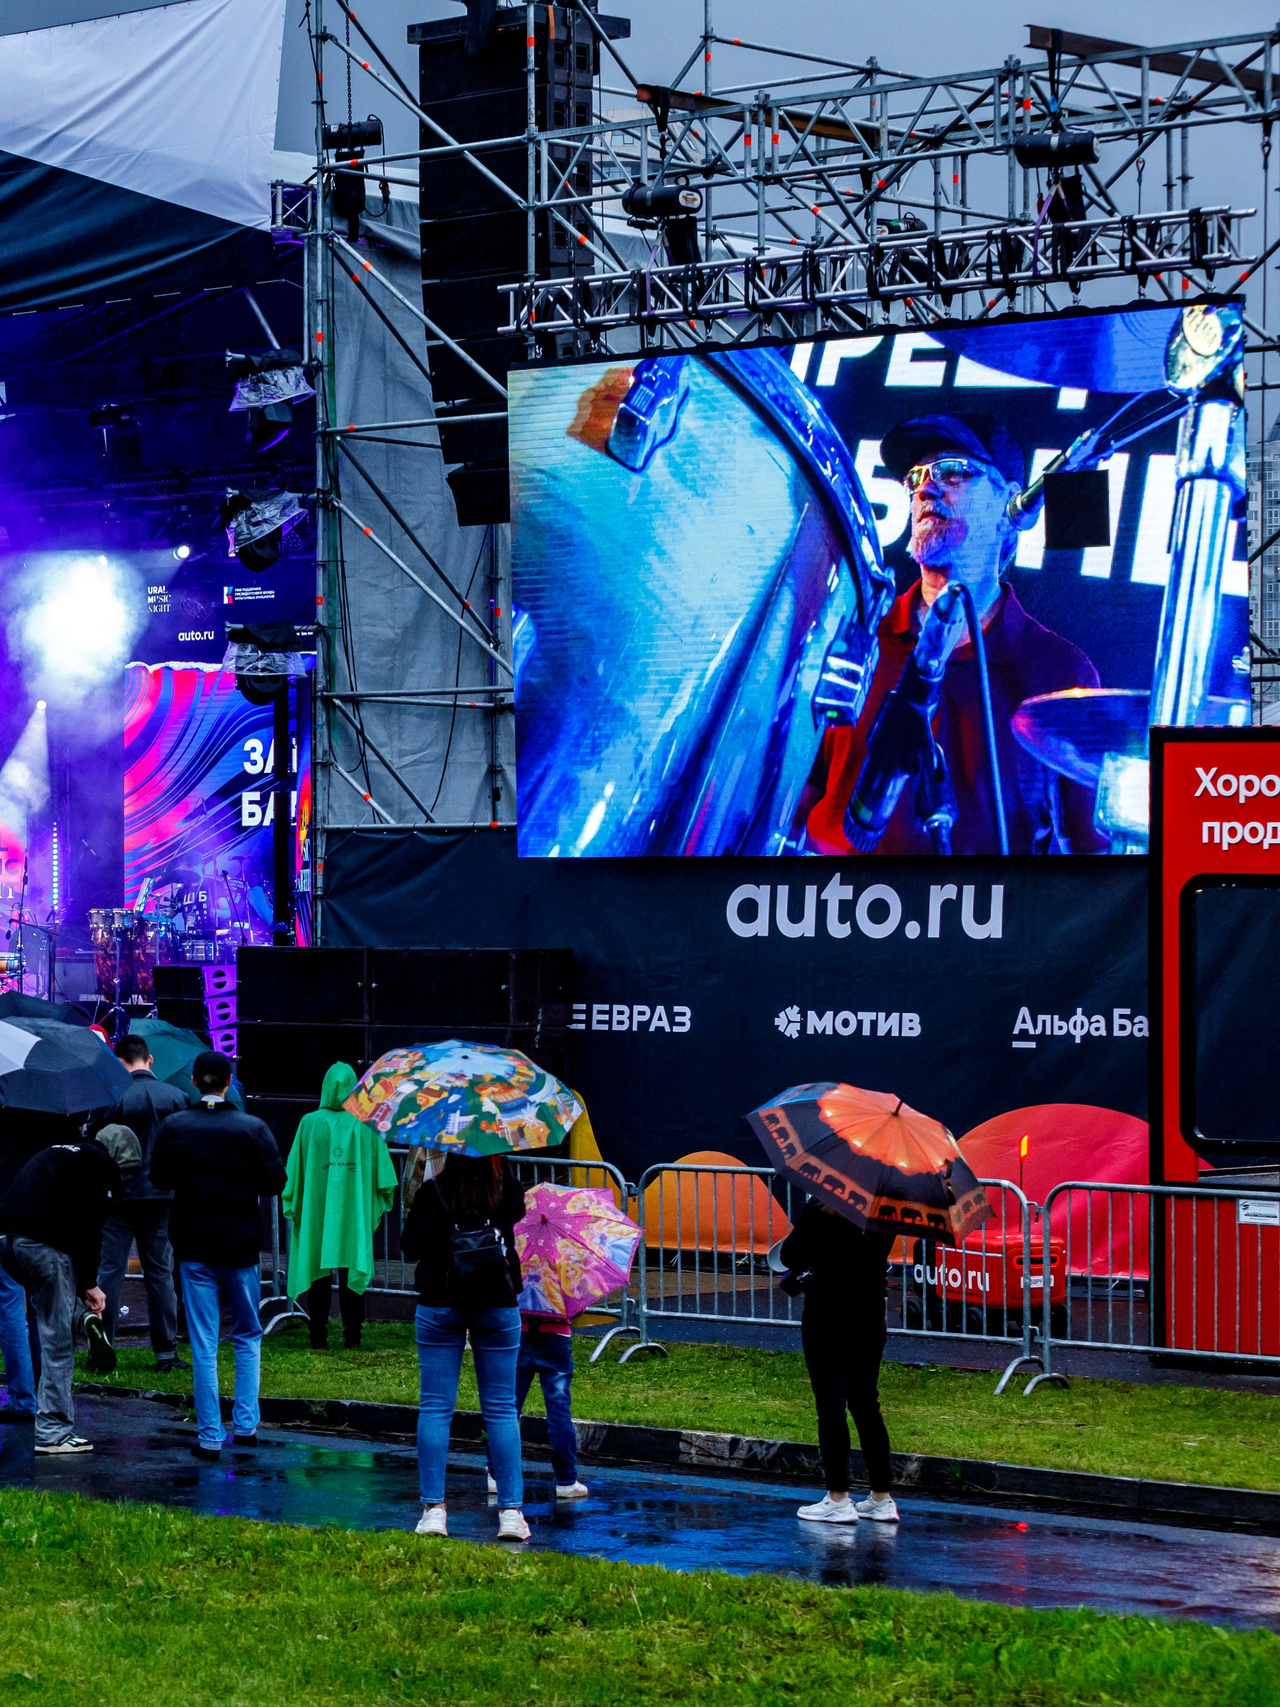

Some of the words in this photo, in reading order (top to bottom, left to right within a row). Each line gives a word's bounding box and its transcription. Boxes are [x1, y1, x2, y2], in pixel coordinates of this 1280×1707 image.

[147, 585, 169, 595] URAL
[178, 630, 215, 642] auto.ru
[1194, 766, 1280, 804] Хоро
[1202, 821, 1280, 851] прод
[726, 872, 1005, 940] auto.ru
[591, 1003, 692, 1033] ЕВРАЗ
[806, 1010, 922, 1037] МОТИВ
[1012, 1006, 1108, 1044] Альфа
[1113, 1007, 1150, 1038] Ба
